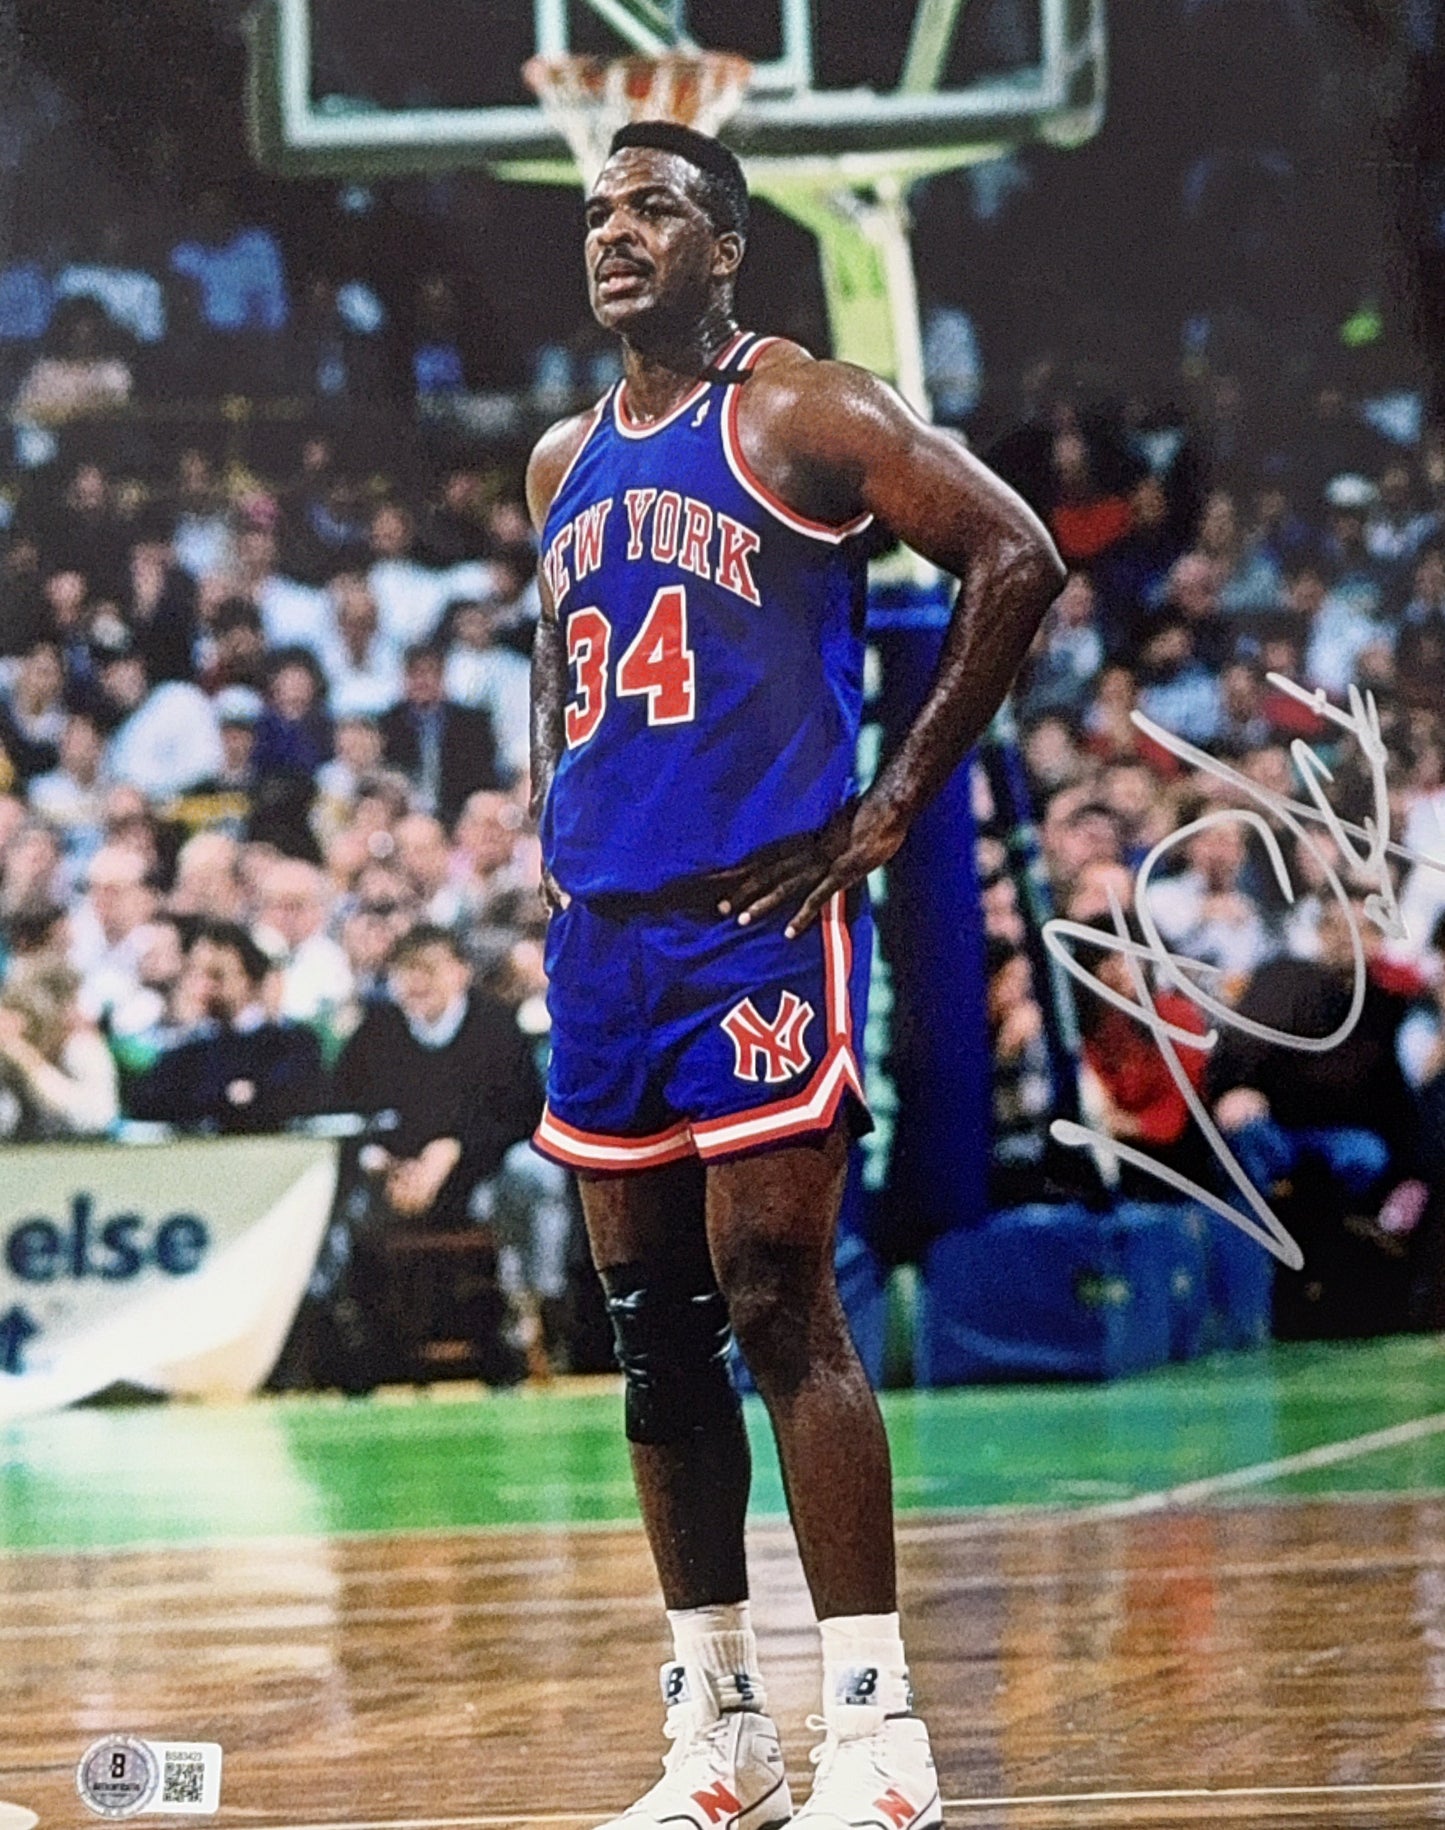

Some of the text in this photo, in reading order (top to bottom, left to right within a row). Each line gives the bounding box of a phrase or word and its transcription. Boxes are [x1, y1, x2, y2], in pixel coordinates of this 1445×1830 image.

[624, 488, 761, 607] YORK
[565, 584, 695, 750] 34
[720, 989, 815, 1082] NY
[6, 1191, 210, 1282] else
[690, 1780, 743, 1824] N
[873, 1787, 917, 1829] N
